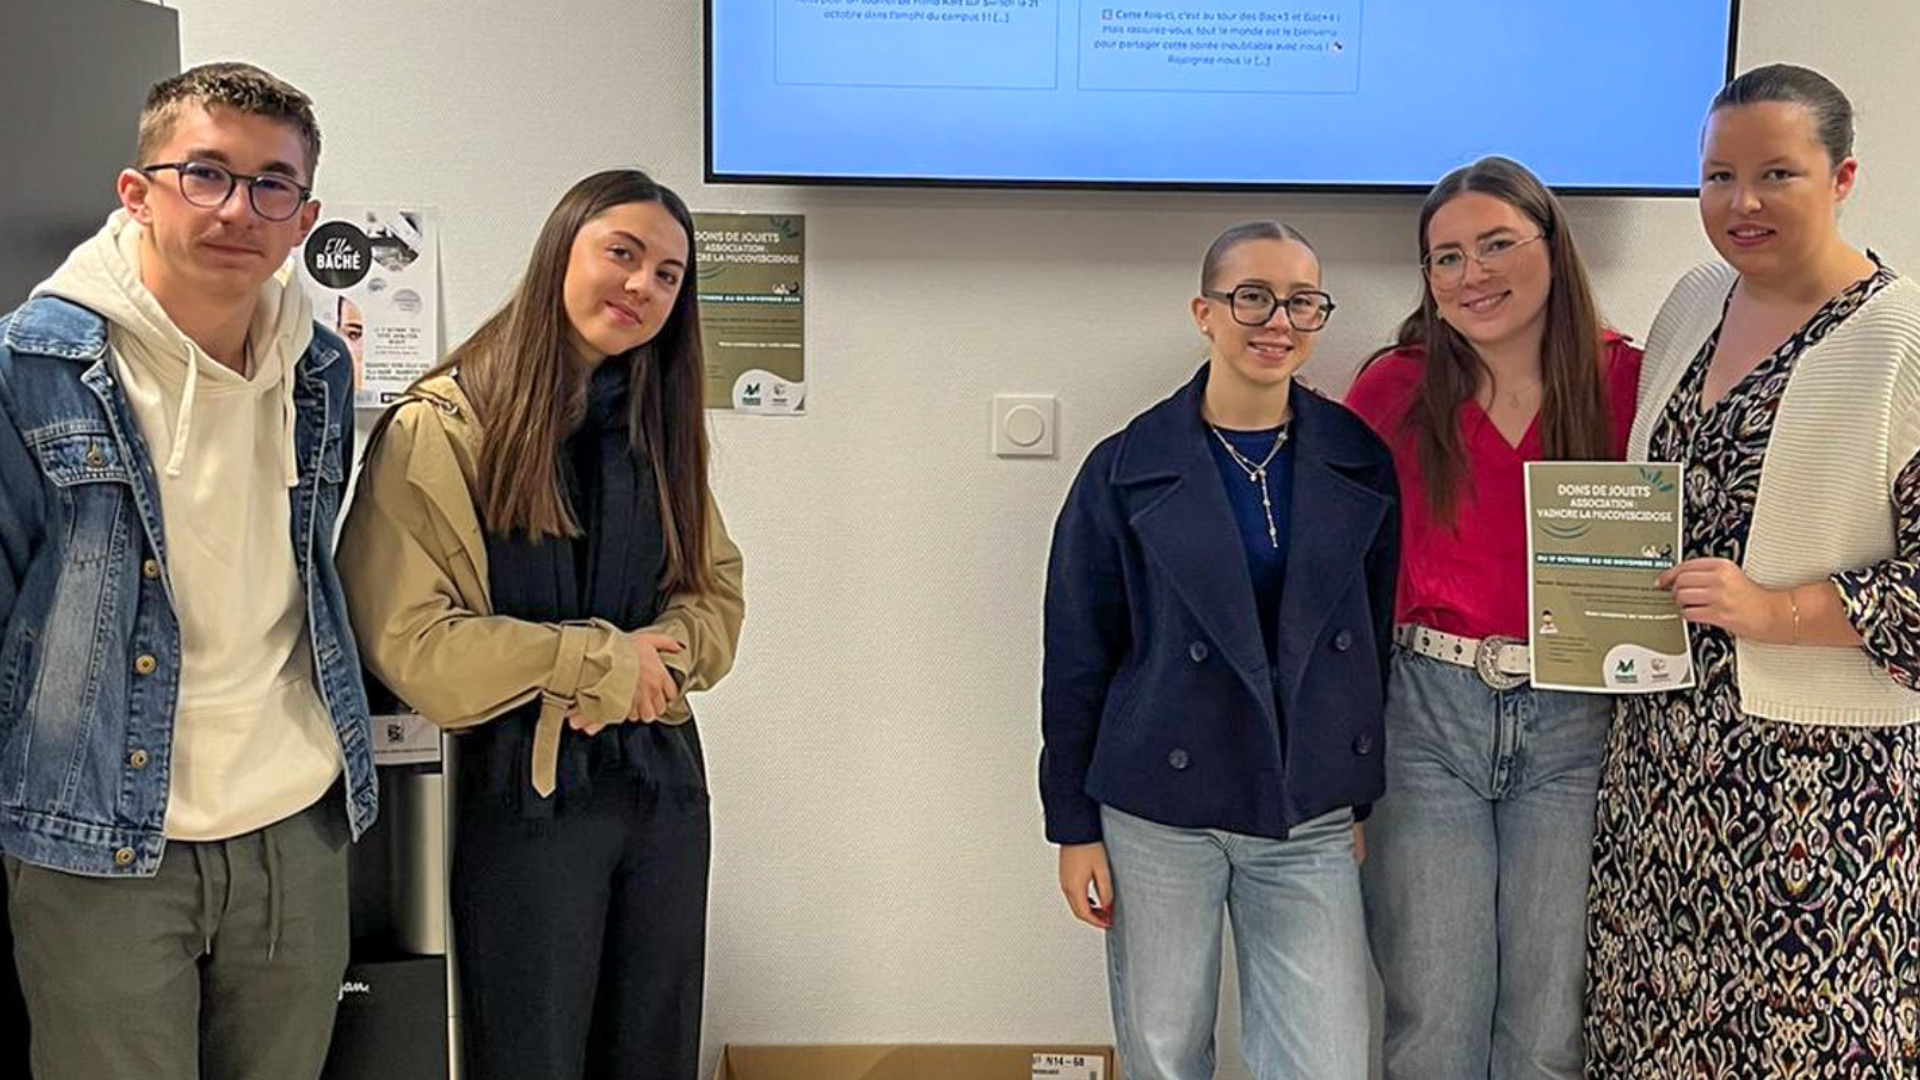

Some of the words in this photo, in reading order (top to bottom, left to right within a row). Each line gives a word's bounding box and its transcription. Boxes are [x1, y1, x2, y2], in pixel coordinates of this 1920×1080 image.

[824, 10, 862, 19] octobre
[694, 230, 724, 242] DONS
[725, 231, 740, 242] DE
[741, 232, 780, 243] JOUETS
[316, 250, 361, 270] BACHÉ
[713, 254, 725, 263] LA
[726, 254, 799, 264] MUCOVISCIDOSE
[1557, 484, 1590, 497] DONS
[1592, 485, 1608, 497] DE
[1608, 486, 1651, 498] JOUETS
[1536, 508, 1578, 519] VAINCRE
[1579, 510, 1591, 519] LA
[1592, 510, 1675, 522] MUCOVISCIDOSE
